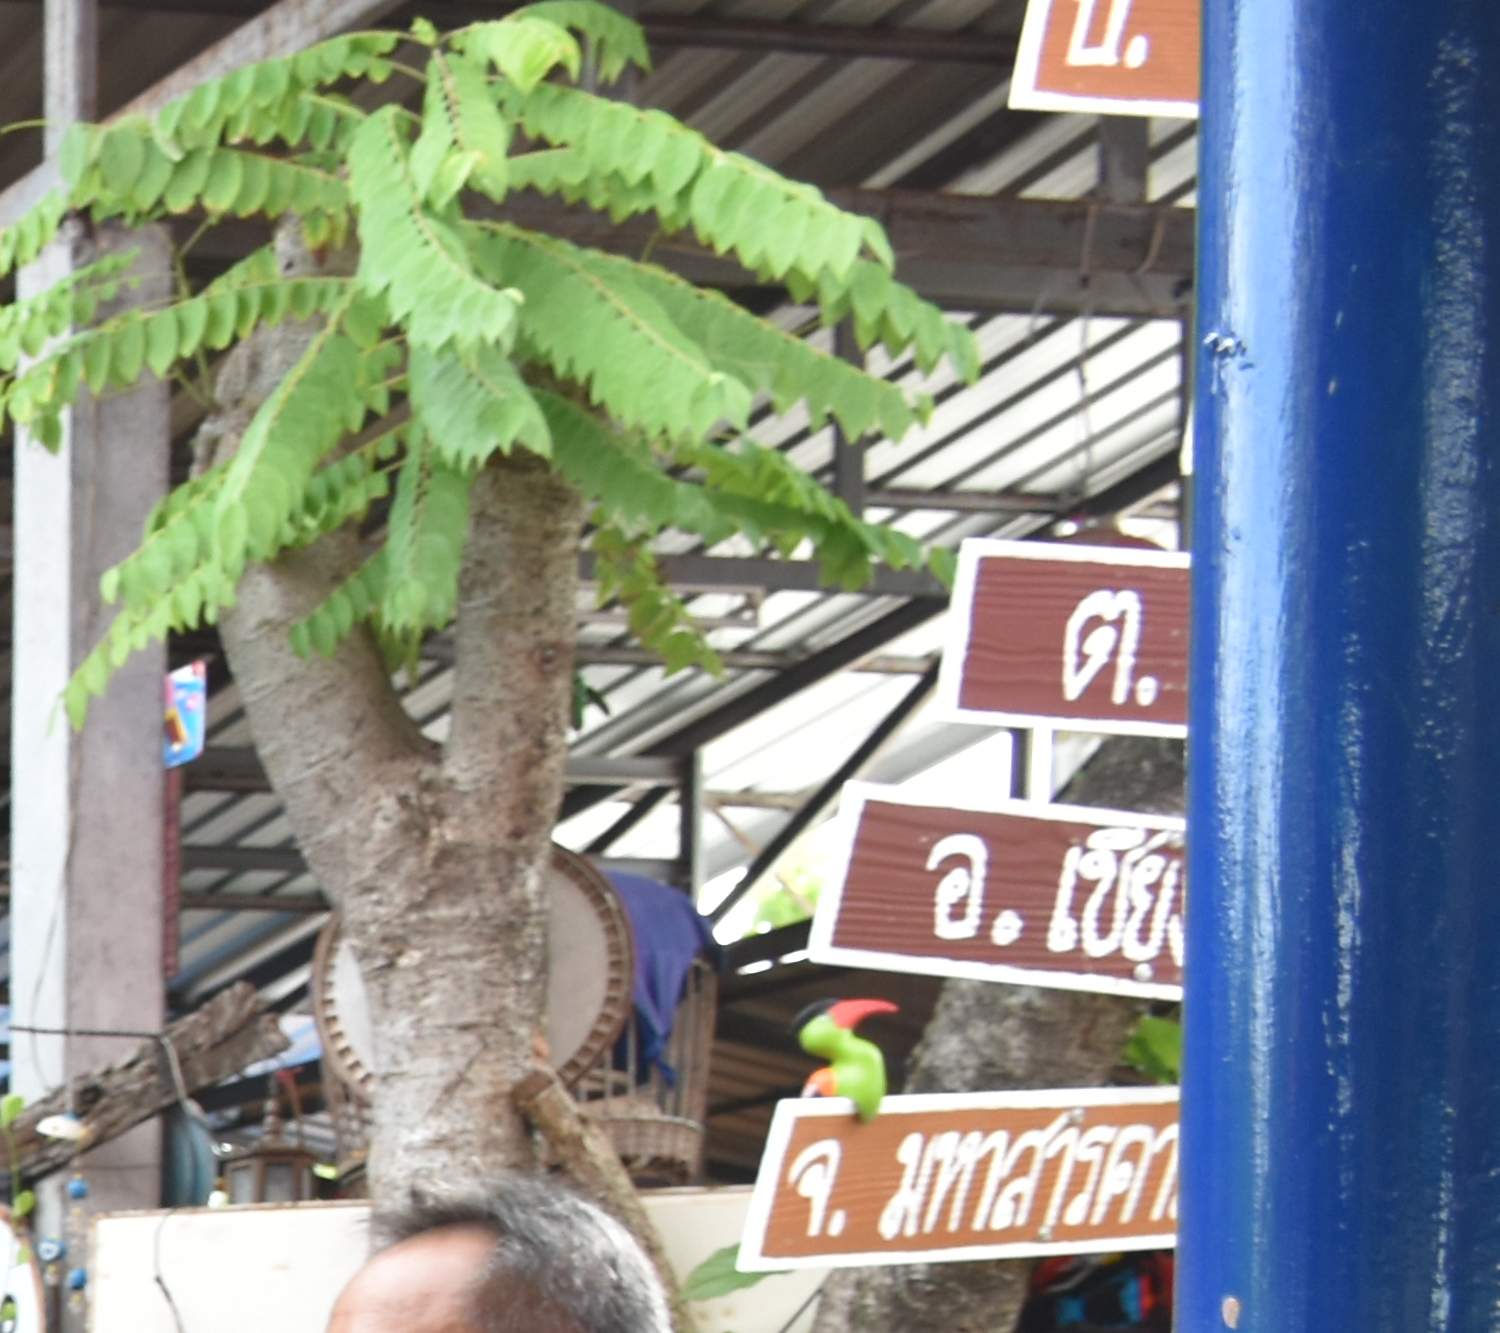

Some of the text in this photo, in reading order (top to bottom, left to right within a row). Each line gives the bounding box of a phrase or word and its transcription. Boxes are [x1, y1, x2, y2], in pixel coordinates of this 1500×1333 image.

[1062, 588, 1160, 706] ต.
[926, 825, 1184, 962] อ. เชีย
[787, 1110, 1178, 1240] จ. มหาสารคา
